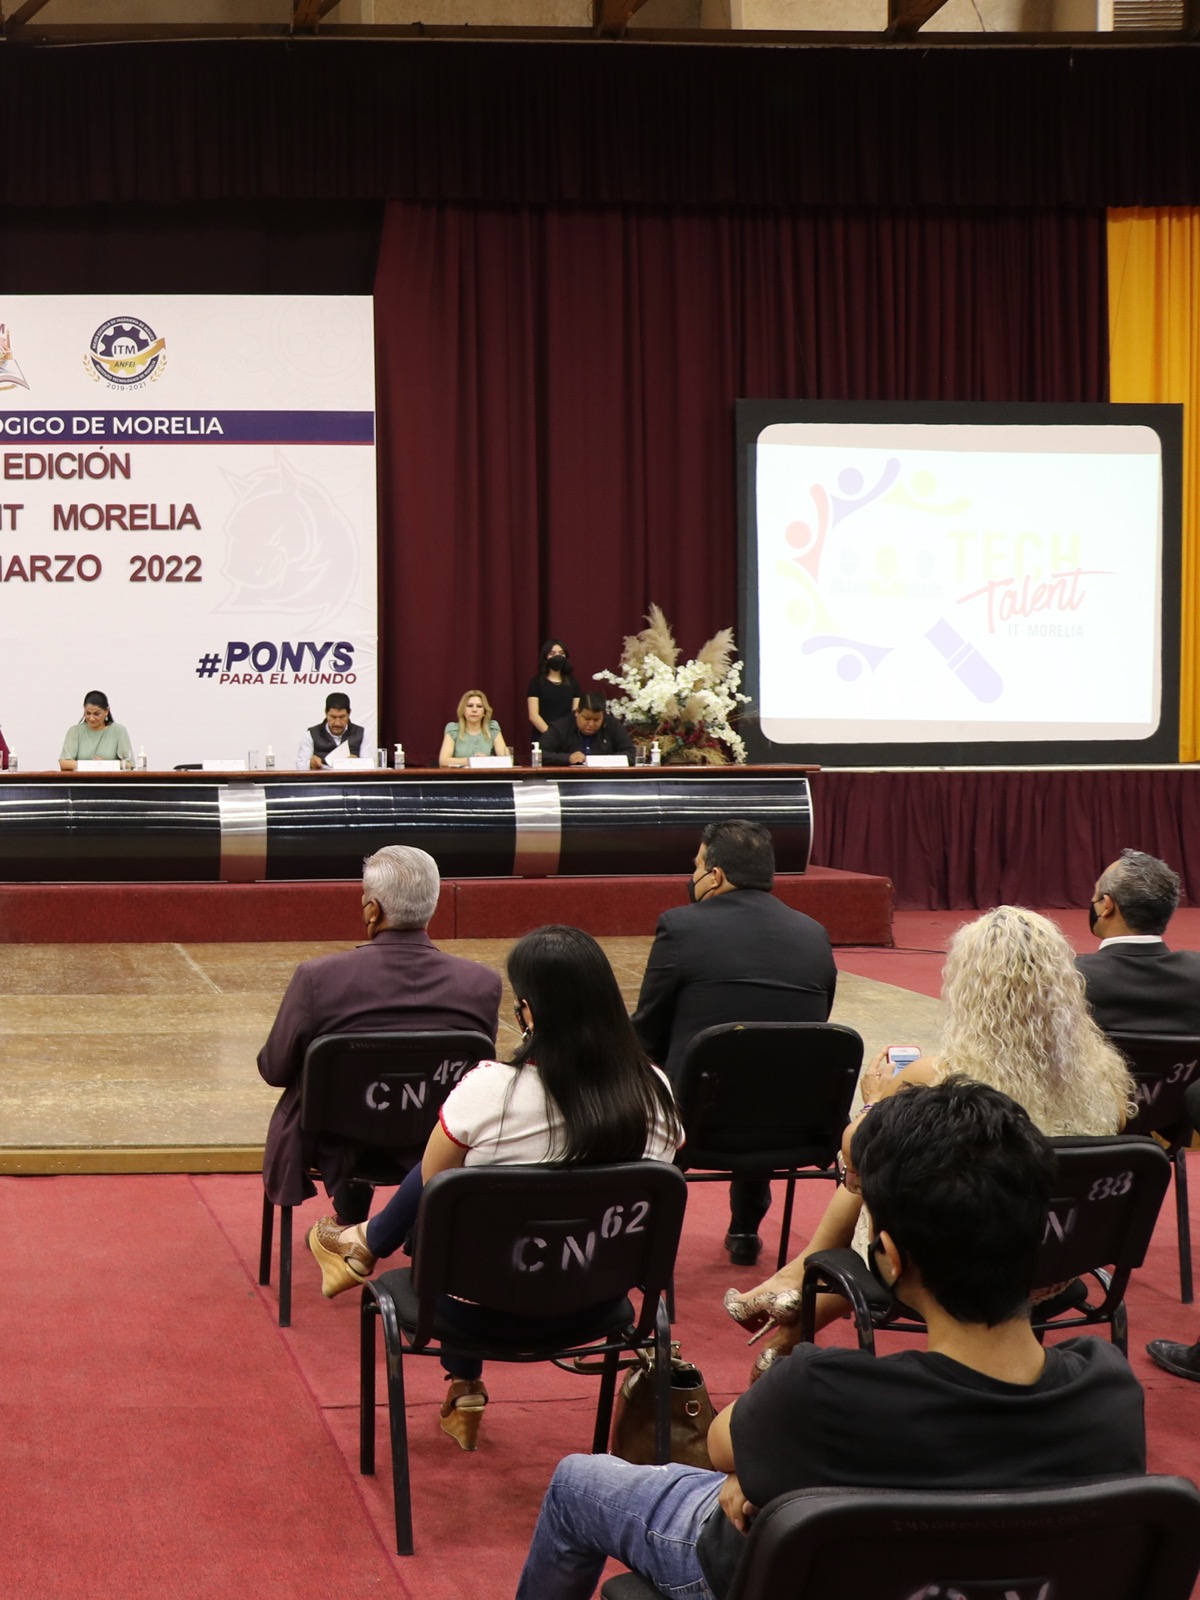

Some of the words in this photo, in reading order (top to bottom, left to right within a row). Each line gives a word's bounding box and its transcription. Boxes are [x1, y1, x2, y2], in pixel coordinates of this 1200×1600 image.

[113, 345, 136, 355] ITM
[106, 381, 147, 391] 2019-2021
[72, 416, 106, 435] DE
[113, 416, 224, 435] MORELIA
[3, 446, 132, 480] EDICIÓN
[53, 503, 202, 531] MORELIA
[129, 554, 203, 583] 2022
[946, 531, 1081, 582] TECH
[956, 568, 1120, 634] Talent
[1027, 624, 1085, 637] MORELIA
[196, 641, 355, 678] #PONYS
[219, 673, 264, 685] PARA
[269, 673, 288, 685] EL
[293, 673, 357, 685] MUNDO
[433, 1060, 468, 1085] 47
[1166, 1060, 1198, 1083] 31
[1088, 1171, 1134, 1200] 88
[601, 1201, 649, 1239] 62
